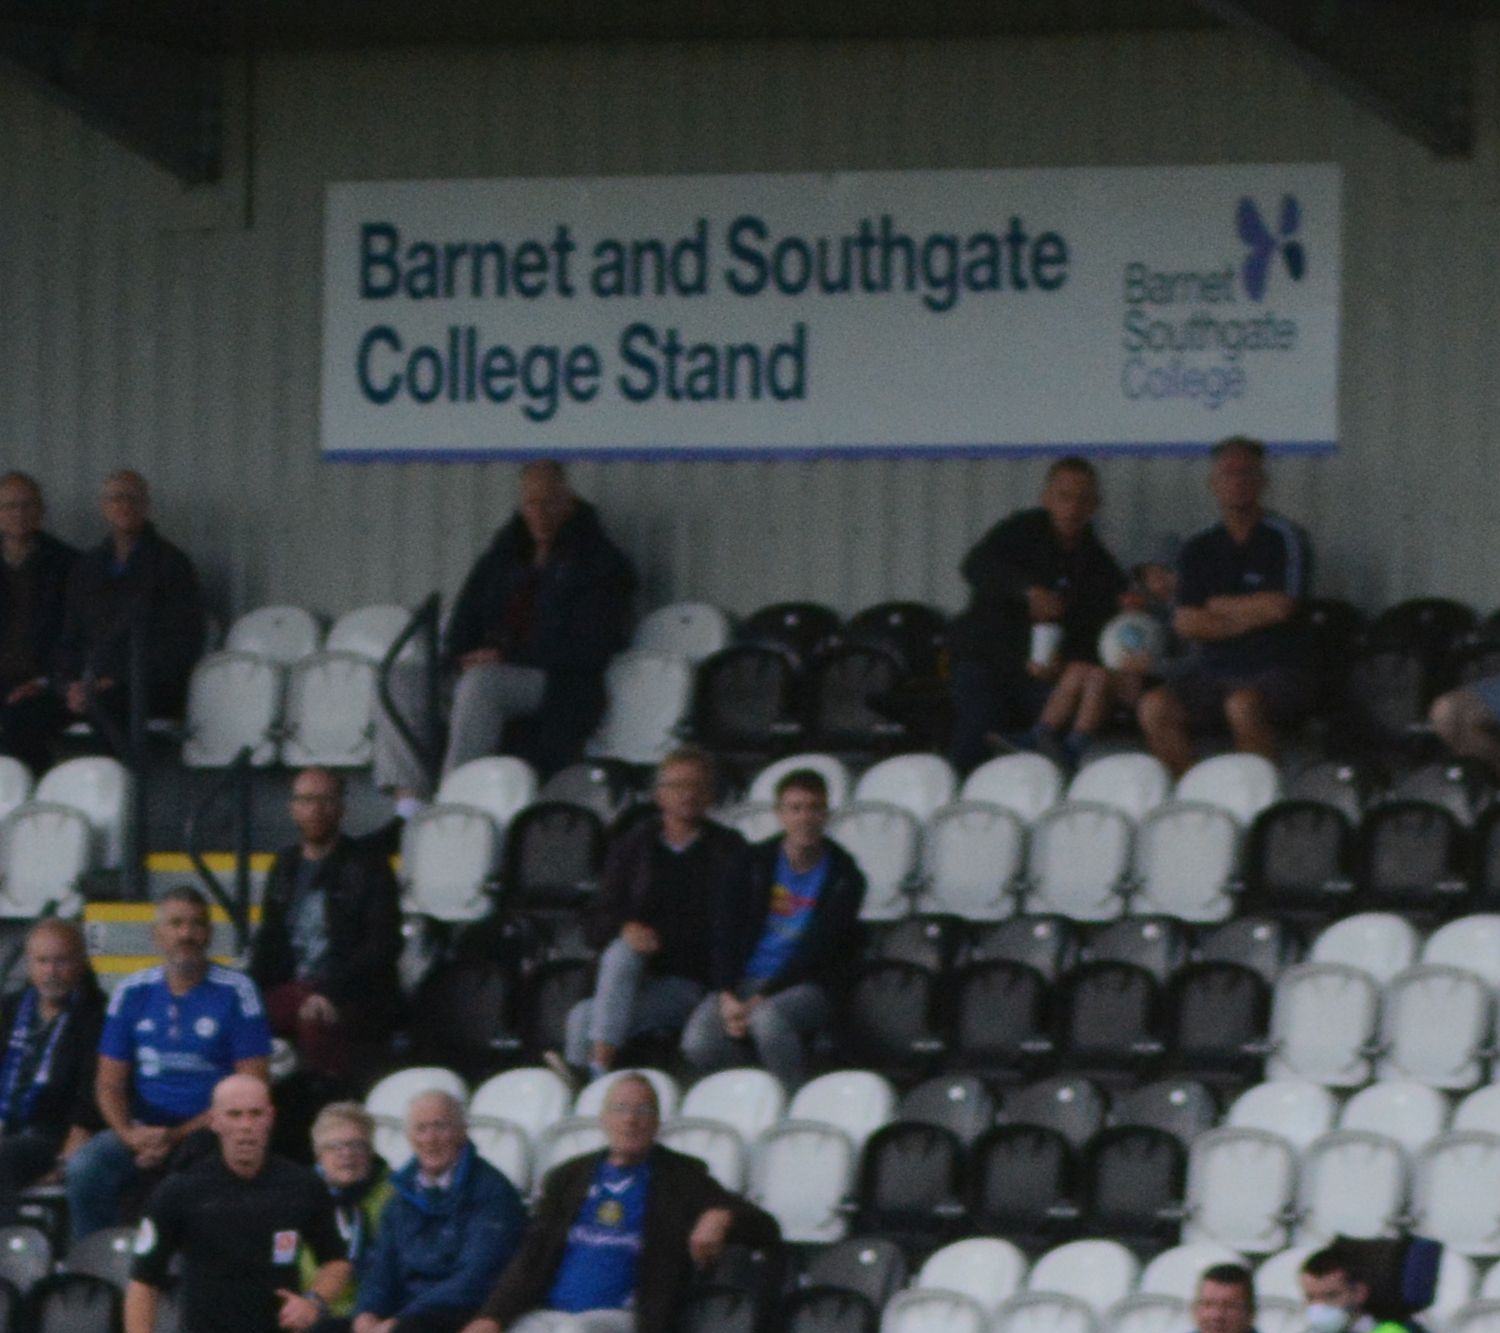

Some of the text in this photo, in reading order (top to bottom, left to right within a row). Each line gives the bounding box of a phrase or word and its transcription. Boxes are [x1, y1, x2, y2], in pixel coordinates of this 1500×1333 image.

[357, 214, 1070, 313] Barnet and Southgate
[1124, 261, 1236, 304] Barnet
[356, 322, 809, 423] College Stand
